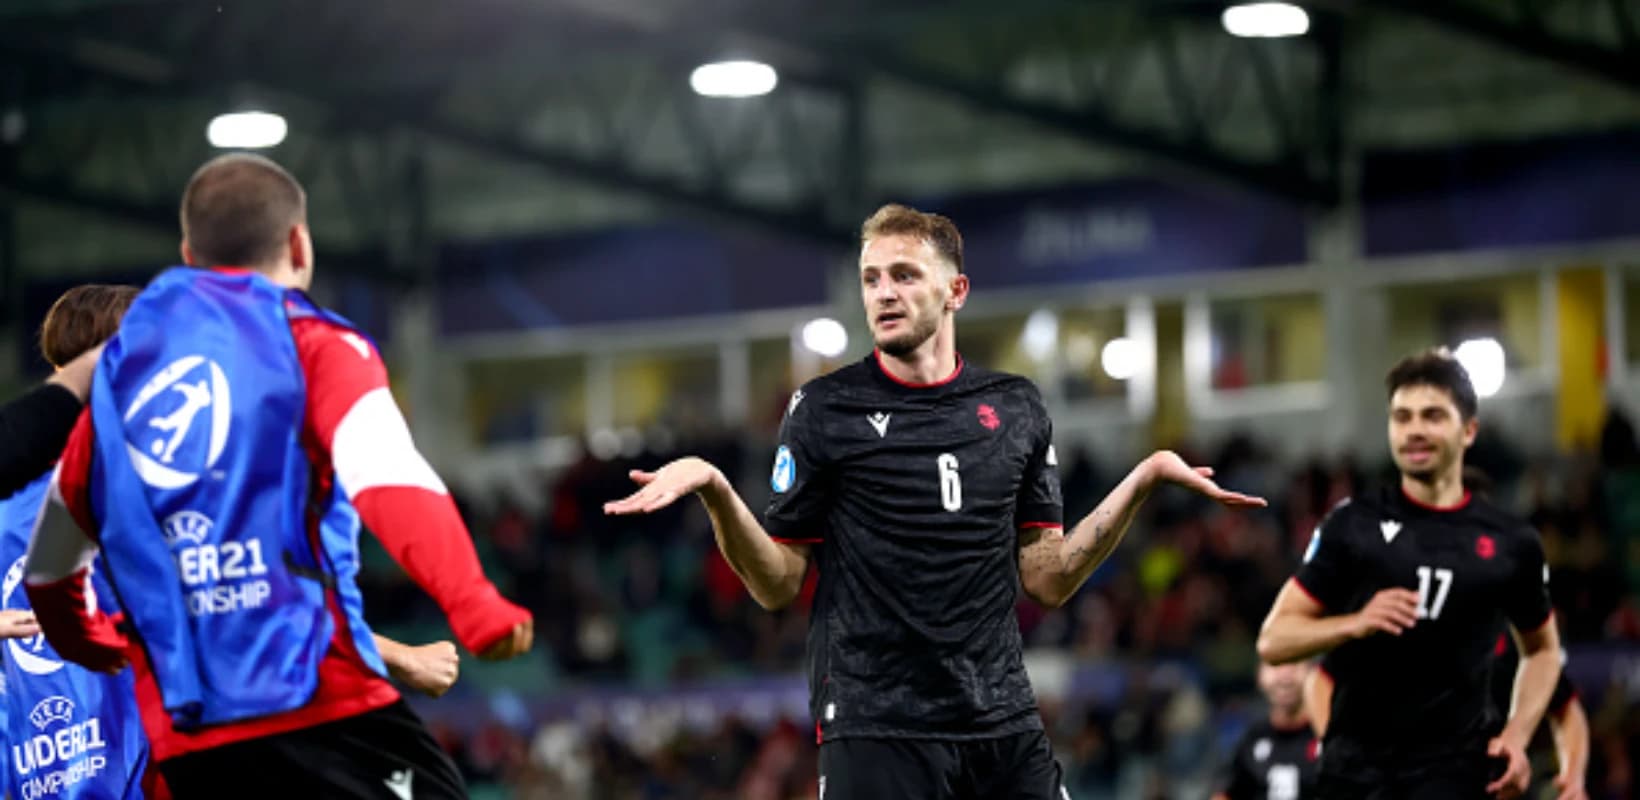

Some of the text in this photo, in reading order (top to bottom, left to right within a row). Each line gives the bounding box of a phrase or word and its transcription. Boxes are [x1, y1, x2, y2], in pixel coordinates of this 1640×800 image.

[937, 452, 963, 512] 6
[179, 538, 268, 586] ER21
[1416, 566, 1454, 620] 17
